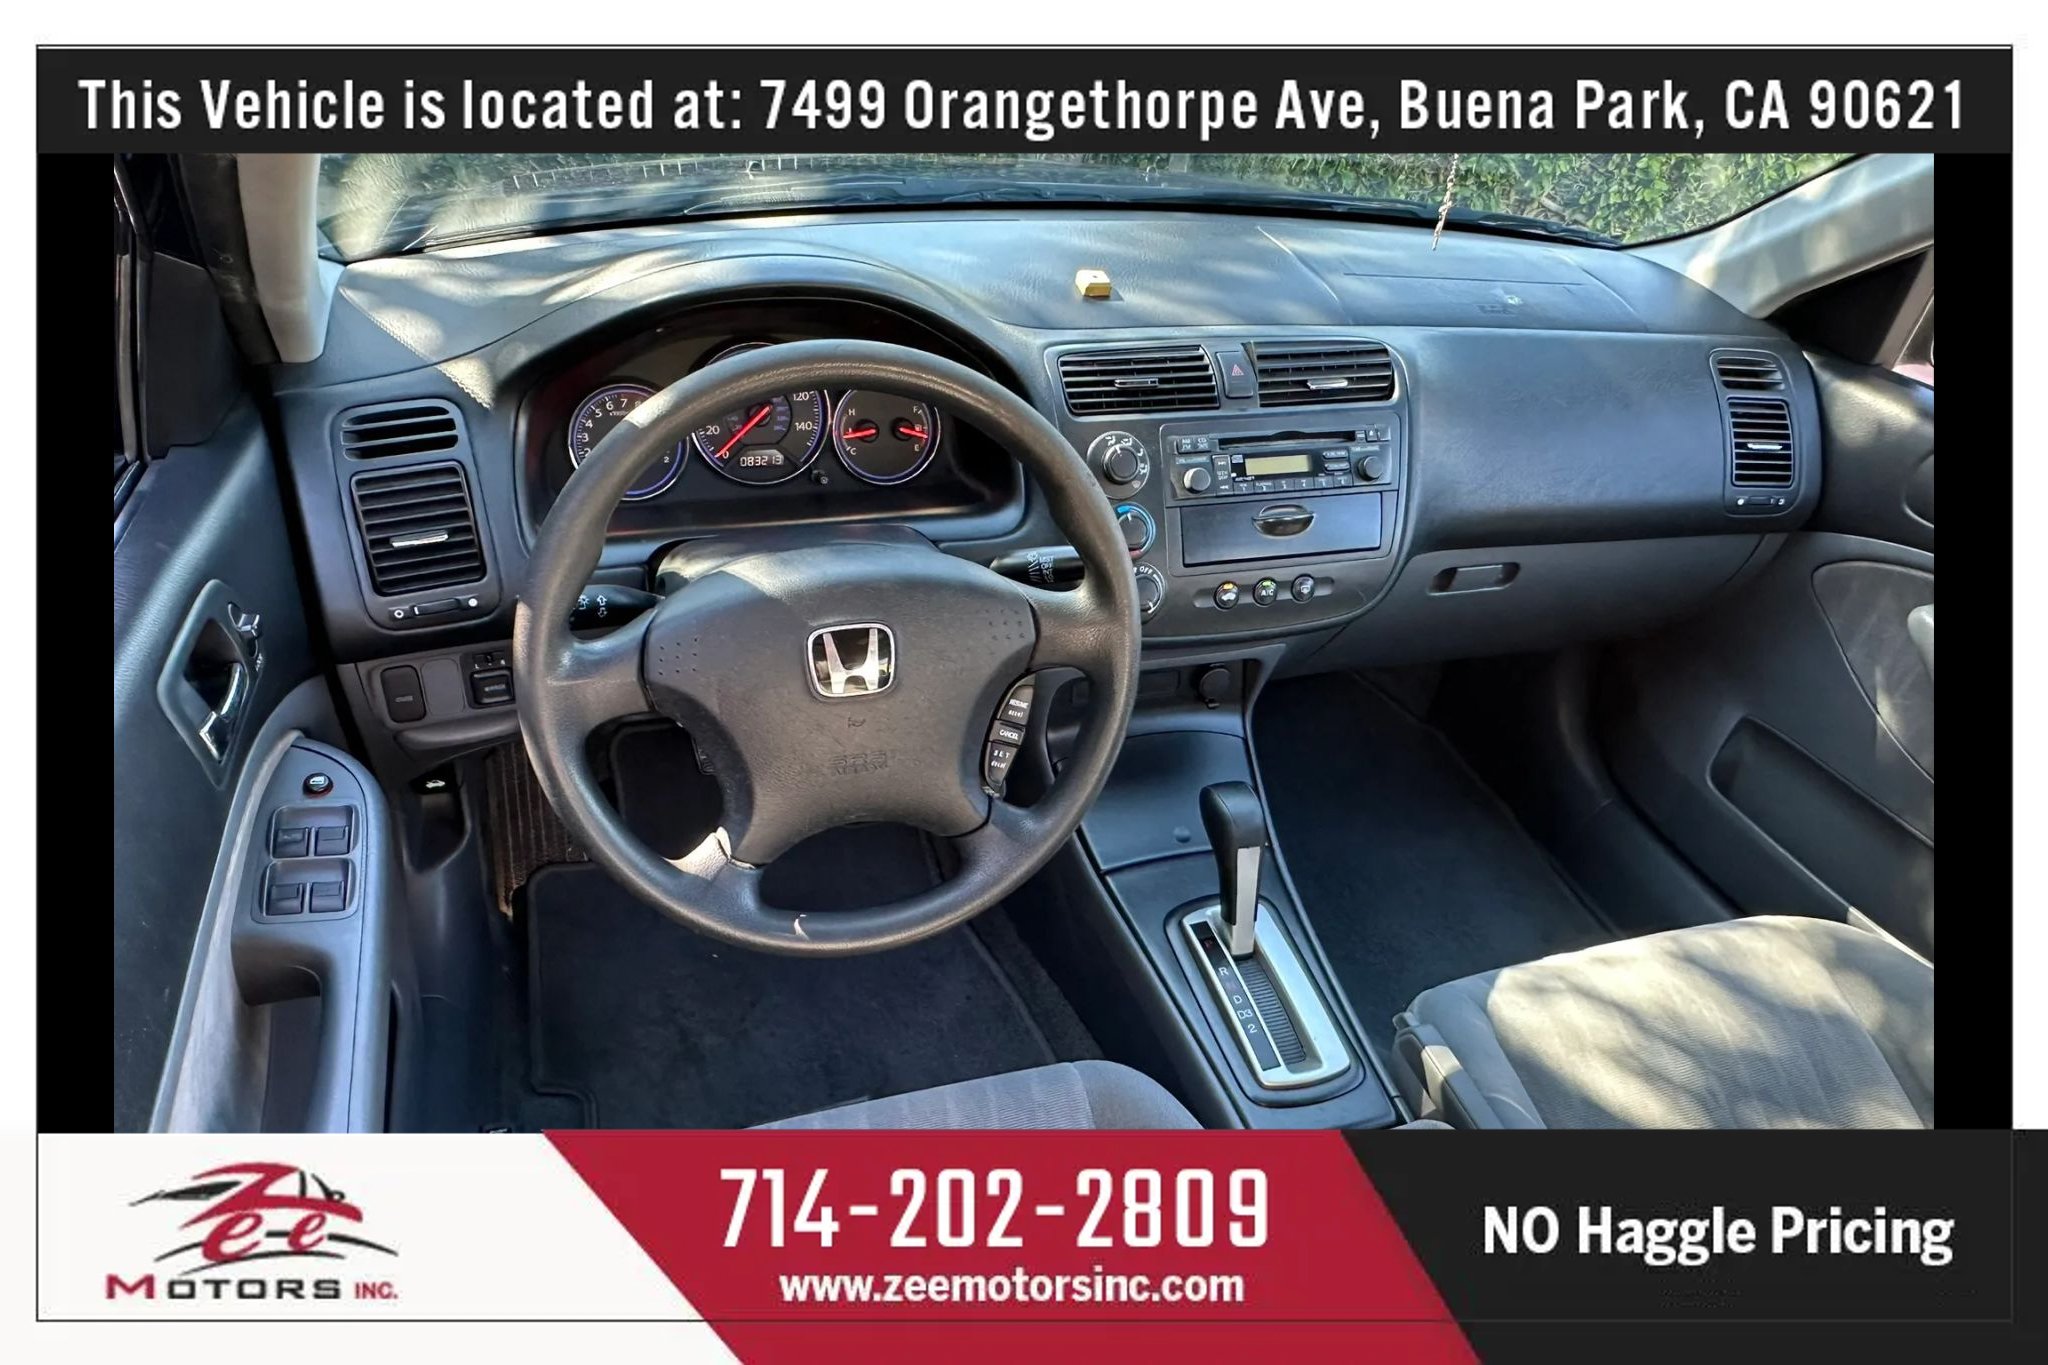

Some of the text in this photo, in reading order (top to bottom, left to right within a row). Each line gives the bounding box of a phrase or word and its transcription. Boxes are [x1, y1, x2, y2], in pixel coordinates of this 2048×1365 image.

[793, 391, 809, 401] 120
[606, 402, 614, 410] 6
[621, 399, 627, 408] 7
[595, 409, 602, 418] 5
[848, 408, 856, 416] H
[585, 420, 593, 428] 4
[795, 421, 812, 431] 140
[706, 425, 720, 435] 20
[850, 447, 857, 455] C
[740, 455, 782, 467] 083213
[993, 750, 1010, 758] SET
[1218, 966, 1229, 976] R
[1233, 995, 1243, 1004] D
[1238, 1009, 1253, 1019] D3
[1248, 1023, 1257, 1034] 2
